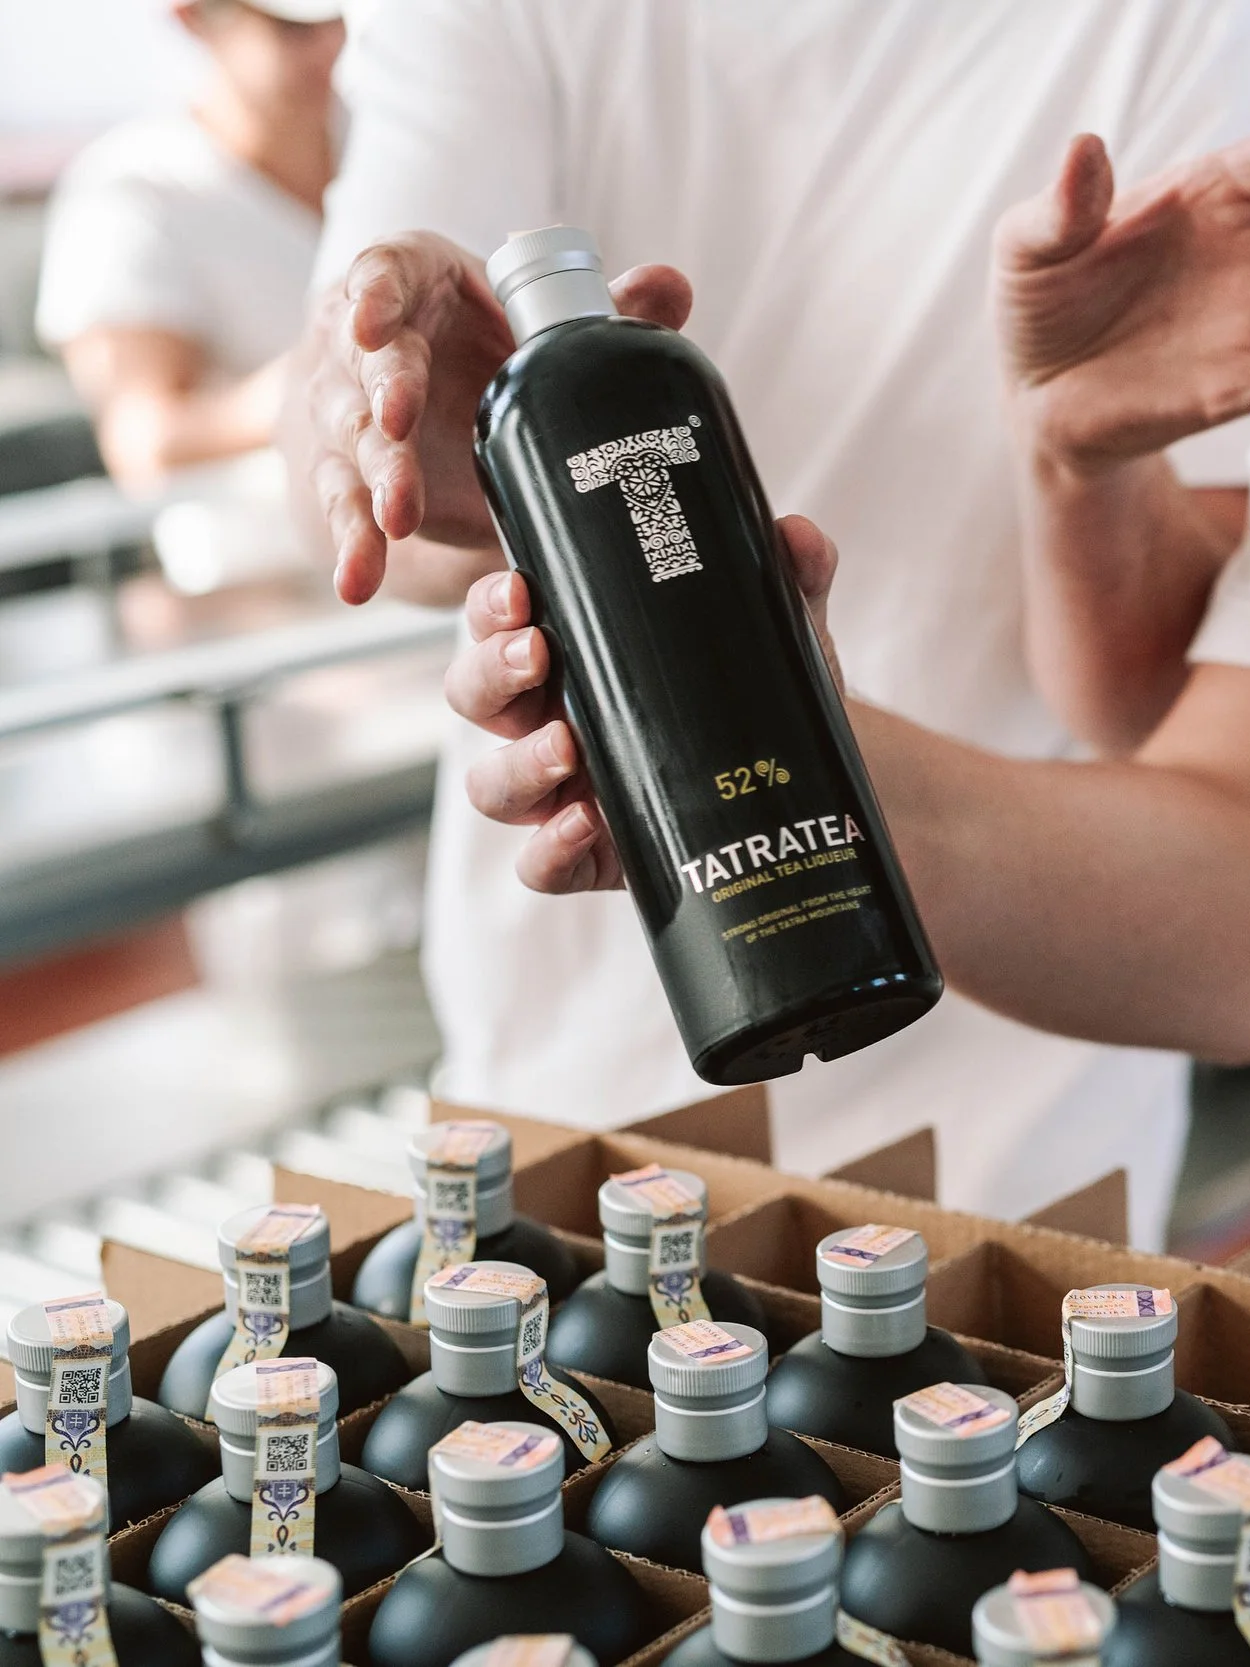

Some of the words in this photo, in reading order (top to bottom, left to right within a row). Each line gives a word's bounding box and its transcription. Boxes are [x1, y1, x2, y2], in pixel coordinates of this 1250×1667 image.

[714, 758, 791, 801] 52%
[681, 814, 865, 894] TATRATEA
[711, 871, 775, 904] ORIGINAL
[775, 861, 804, 878] TEA
[806, 848, 857, 870] LIQUEUR
[828, 890, 847, 901] THE
[778, 914, 808, 930] TATRA
[809, 900, 861, 921] MOUNTAINS
